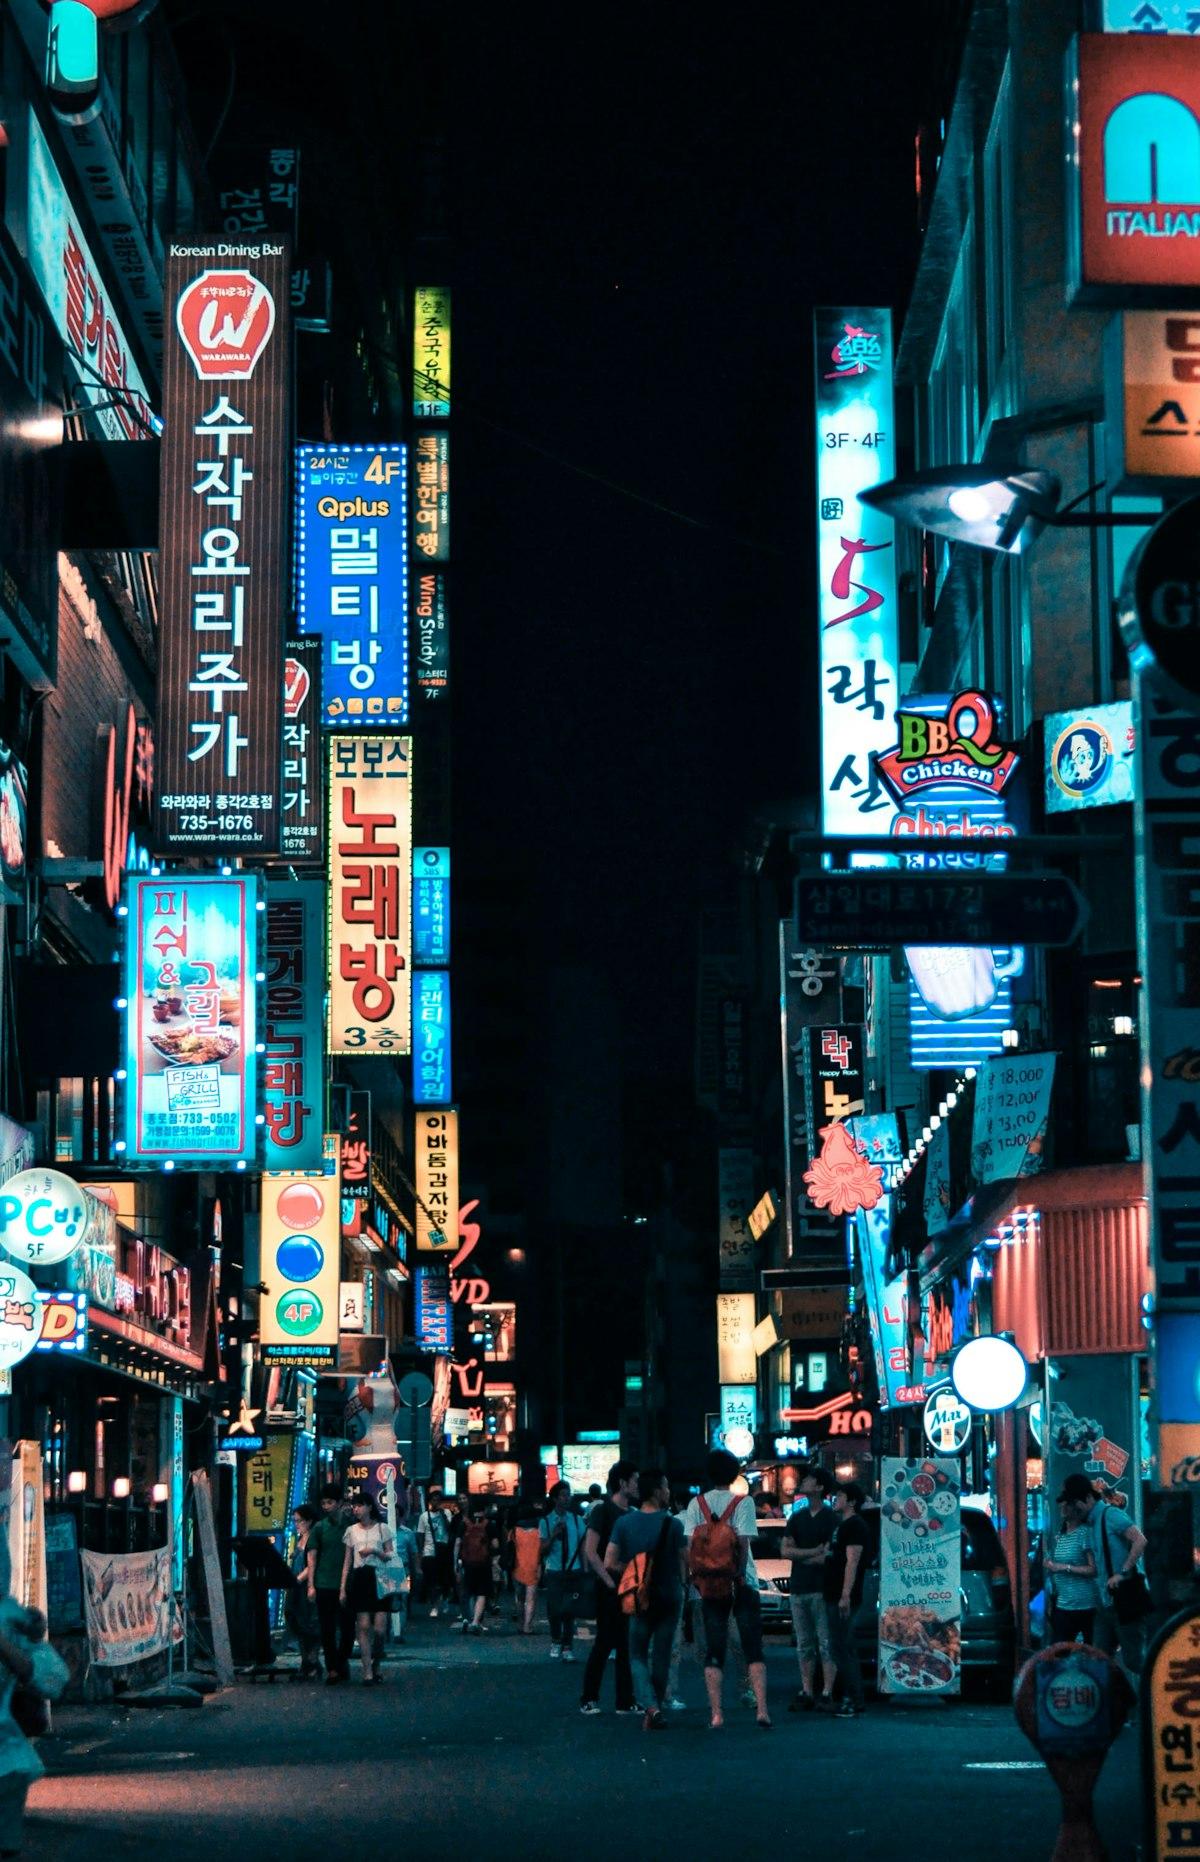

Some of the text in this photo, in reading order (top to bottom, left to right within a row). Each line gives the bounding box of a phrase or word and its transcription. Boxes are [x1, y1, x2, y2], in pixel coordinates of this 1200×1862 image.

[170, 243, 284, 259] Korean Dining Bar
[201, 353, 251, 361] WARAWARA
[309, 456, 350, 470] 24시간
[363, 454, 401, 486] 4F
[317, 495, 391, 521] Qplus
[187, 395, 254, 777] 수작요리주가
[416, 575, 436, 617] Wing
[328, 527, 383, 692] 멀티방
[306, 639, 319, 648] Bar
[418, 618, 436, 667] Study
[425, 688, 440, 699] 7F
[899, 690, 1004, 766] BBQ
[336, 741, 408, 779] 보보스
[901, 761, 994, 787] Chicken
[161, 794, 274, 810] 와라와라 종각2호점
[180, 814, 254, 831] 735-1676
[169, 833, 264, 842] www.wara-wara.co.kr
[337, 786, 405, 1022] 노래방
[152, 888, 188, 958] 피쉬
[344, 1025, 404, 1048] 3층
[818, 1069, 840, 1077] Happy
[180, 1083, 218, 1096] GRILL
[426, 1115, 448, 1225] 이바돔감자탕
[27, 1242, 45, 1258] 5F
[450, 1279, 490, 1304] VD
[284, 1303, 314, 1323] 4F
[930, 1408, 962, 1430] Max
[221, 1437, 263, 1447] SAPPORO
